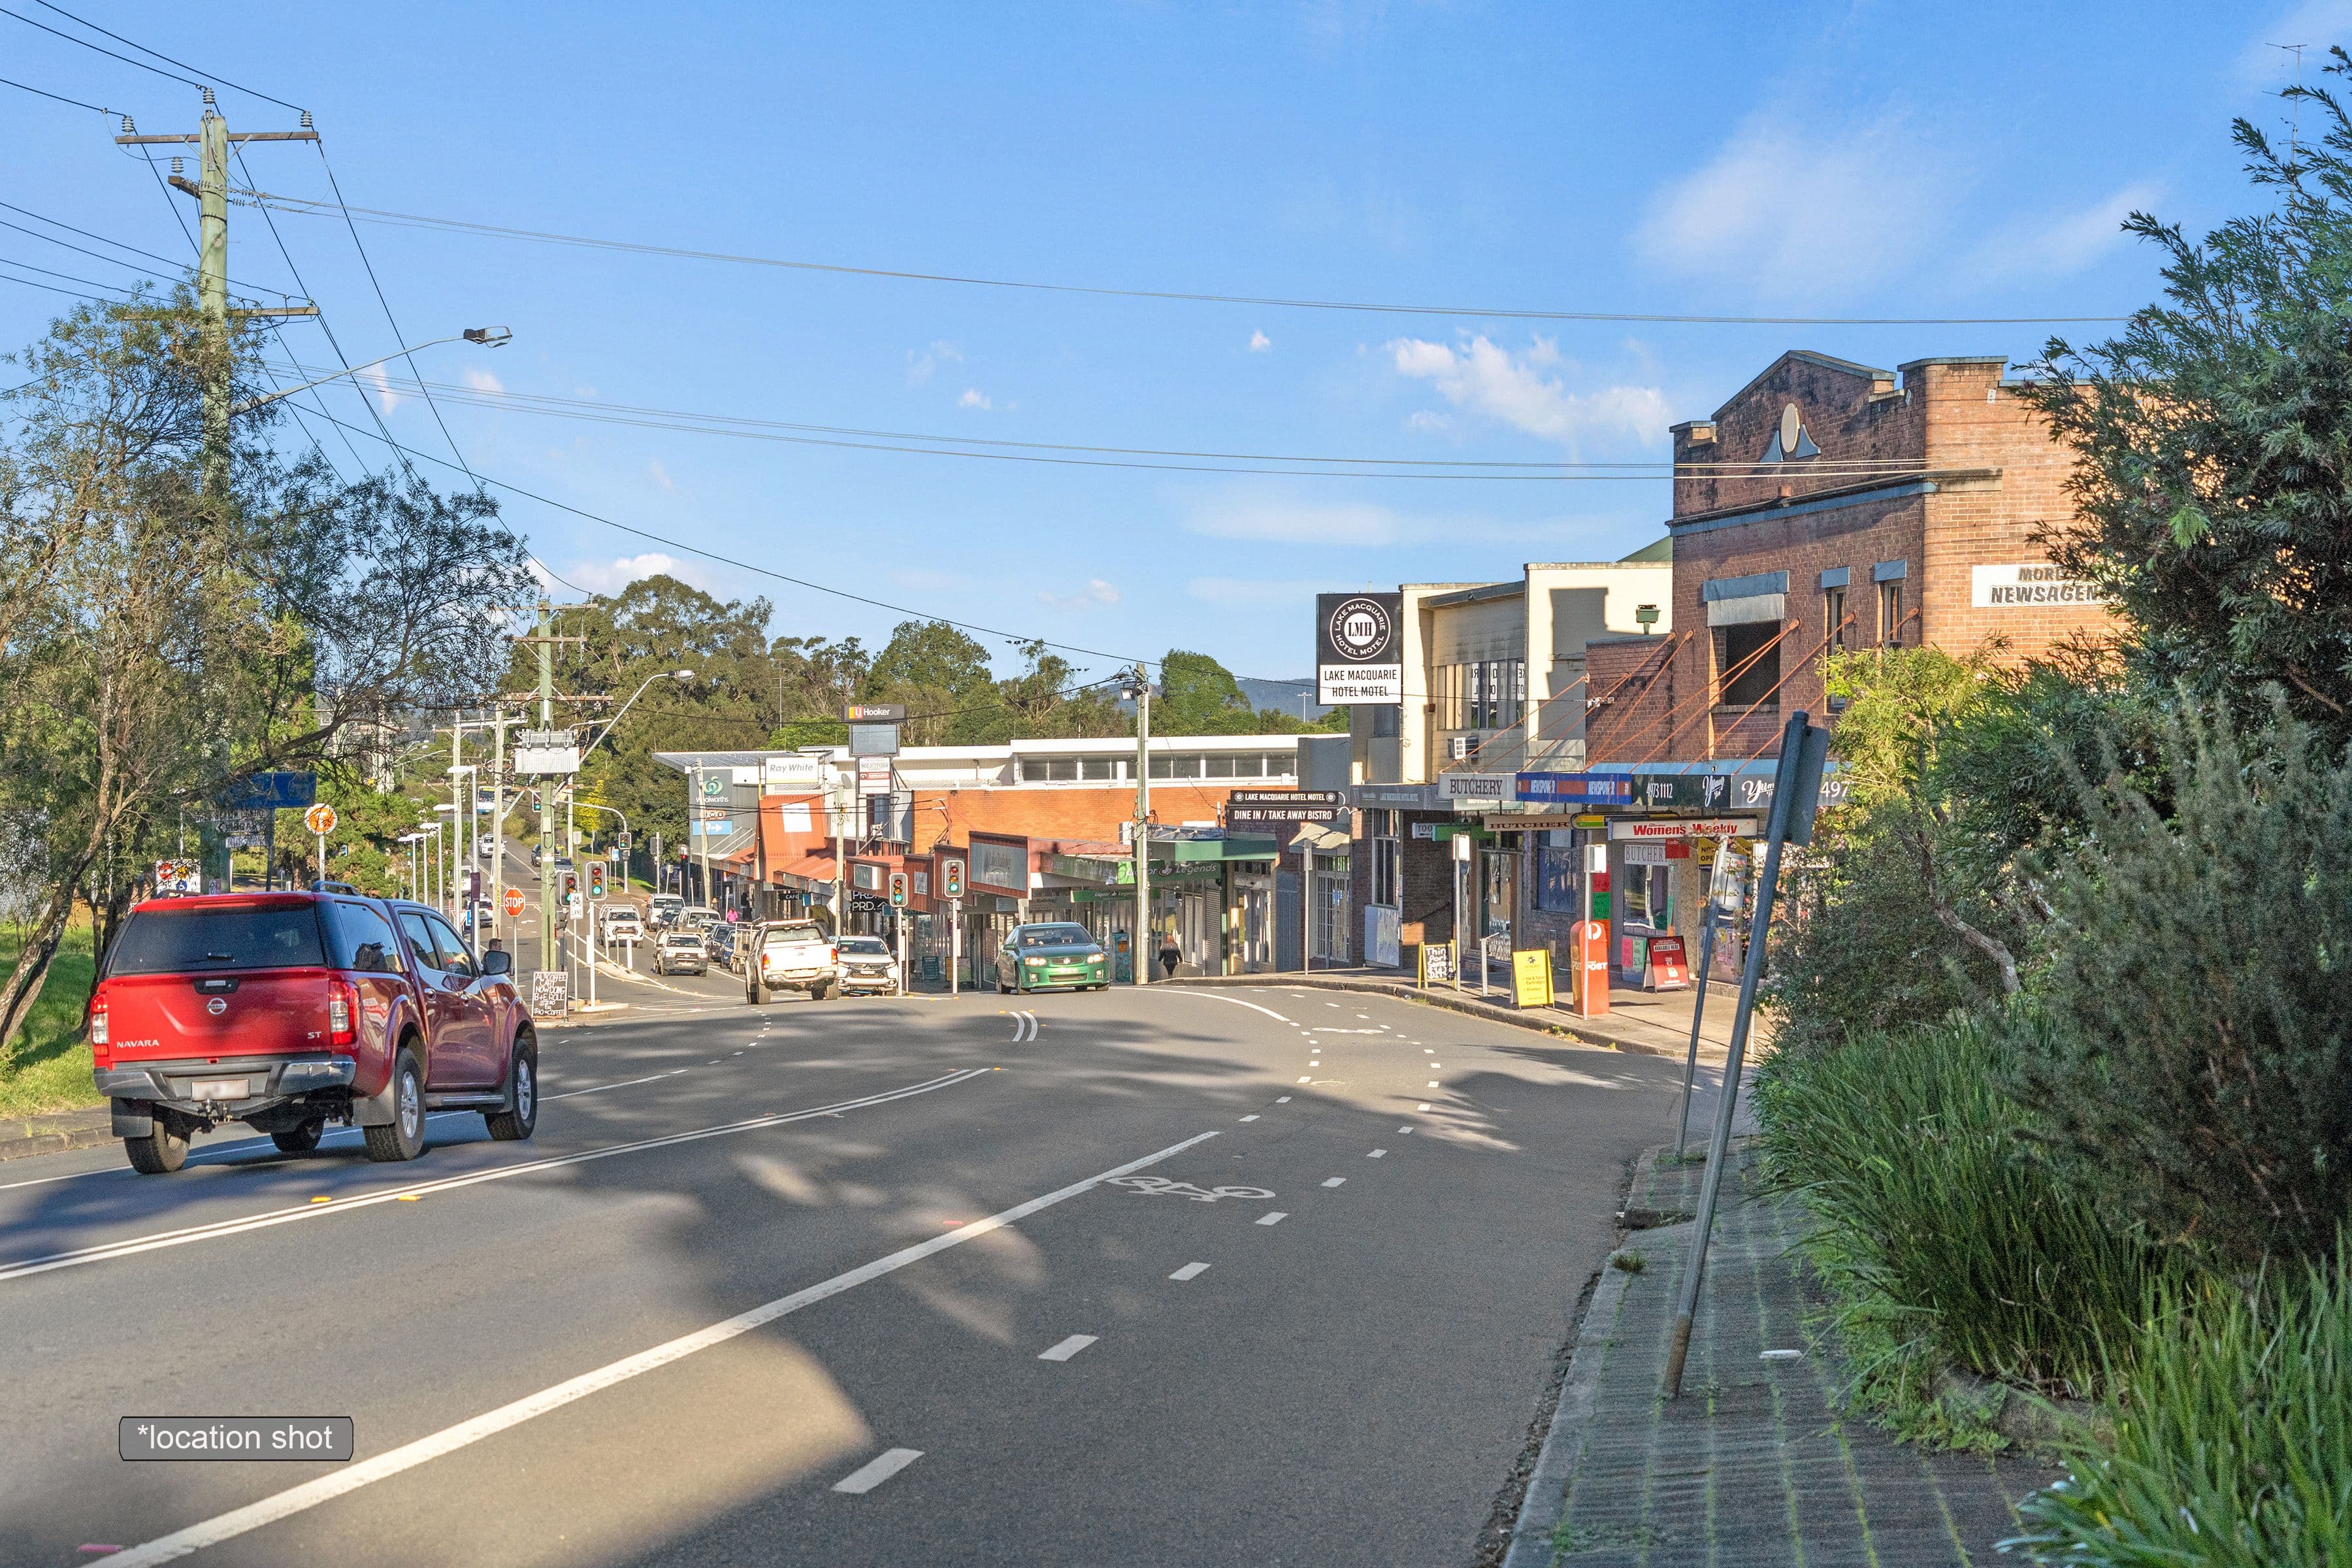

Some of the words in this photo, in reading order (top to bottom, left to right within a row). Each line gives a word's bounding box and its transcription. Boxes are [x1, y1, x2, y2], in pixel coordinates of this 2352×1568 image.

[1335, 609, 1348, 631] LAKE
[1348, 603, 1386, 631] MACQUARIE
[1348, 622, 1372, 636] LMH
[1335, 634, 1358, 655] HOTEL
[1360, 635, 1384, 655] MOTEL
[1324, 670, 1345, 681] LAKE
[1348, 669, 1397, 680] MACQUARIE
[1332, 686, 1359, 697] HOTEL
[1361, 686, 1389, 697] MOTEL
[863, 708, 890, 716] Hooker
[789, 763, 813, 772] White
[1449, 778, 1503, 795] BUTCHERY
[1741, 779, 1775, 804] Yum
[1234, 810, 1252, 820] DINE
[1252, 810, 1262, 820] IN
[1262, 809, 1267, 820] /
[1268, 810, 1286, 820] TAKE
[1286, 810, 1306, 820] AWAY
[1308, 810, 1332, 820] BISTRO
[1633, 824, 1686, 836] Women's
[1691, 823, 1738, 836] Weekly
[1625, 845, 1667, 860] BUTCHER
[1126, 867, 1157, 877] Lior
[1175, 863, 1217, 874] Legends
[505, 897, 523, 907] STOP
[852, 902, 876, 911] PRD.
[1426, 947, 1446, 956] Thin
[549, 986, 566, 994] DOING
[116, 1039, 159, 1049] NAVARA
